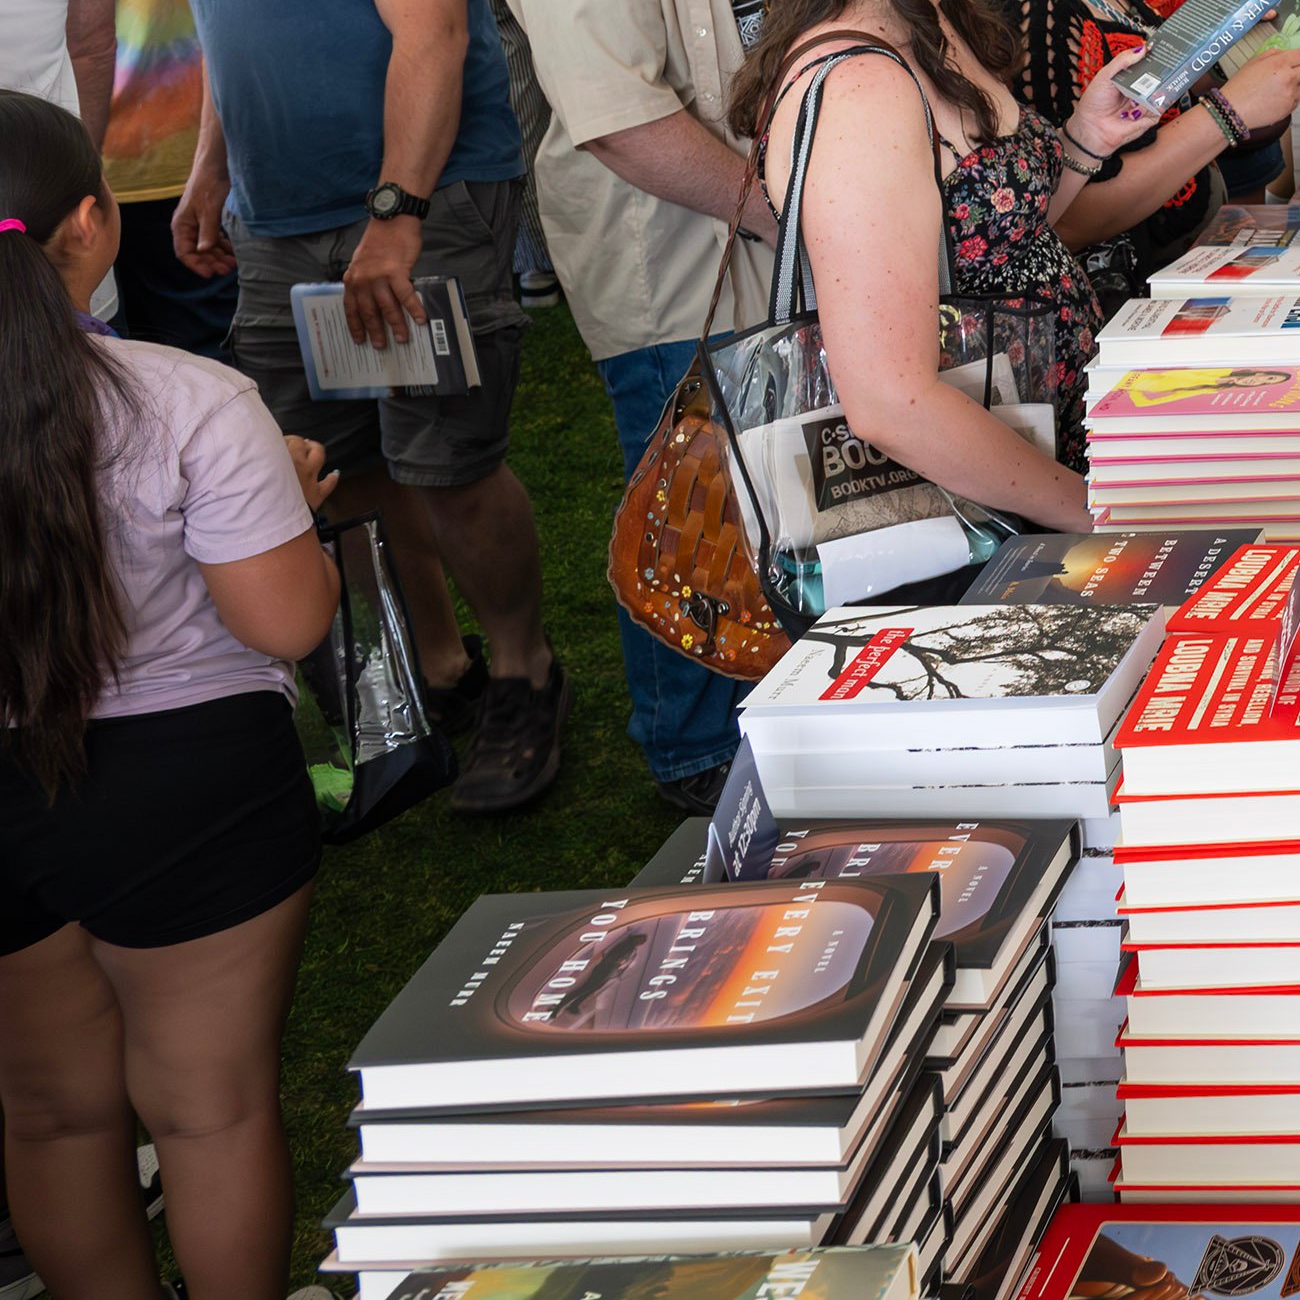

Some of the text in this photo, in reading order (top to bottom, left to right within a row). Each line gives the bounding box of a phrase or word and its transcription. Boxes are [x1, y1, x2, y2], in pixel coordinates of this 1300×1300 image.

[1191, 32, 1234, 73] BLOOD
[1080, 540, 1128, 598] TWO SEAS
[1132, 539, 1178, 596] BETWEEN
[1185, 548, 1221, 595] DESERT
[831, 629, 905, 700] the perfect man
[1133, 639, 1213, 732] LOUBNA MRIE
[448, 921, 524, 1007] NAEEM MURR
[521, 898, 629, 1022] YOU HOME
[639, 910, 716, 1001] BRINGS
[726, 880, 826, 1024] EVERY EXIT
